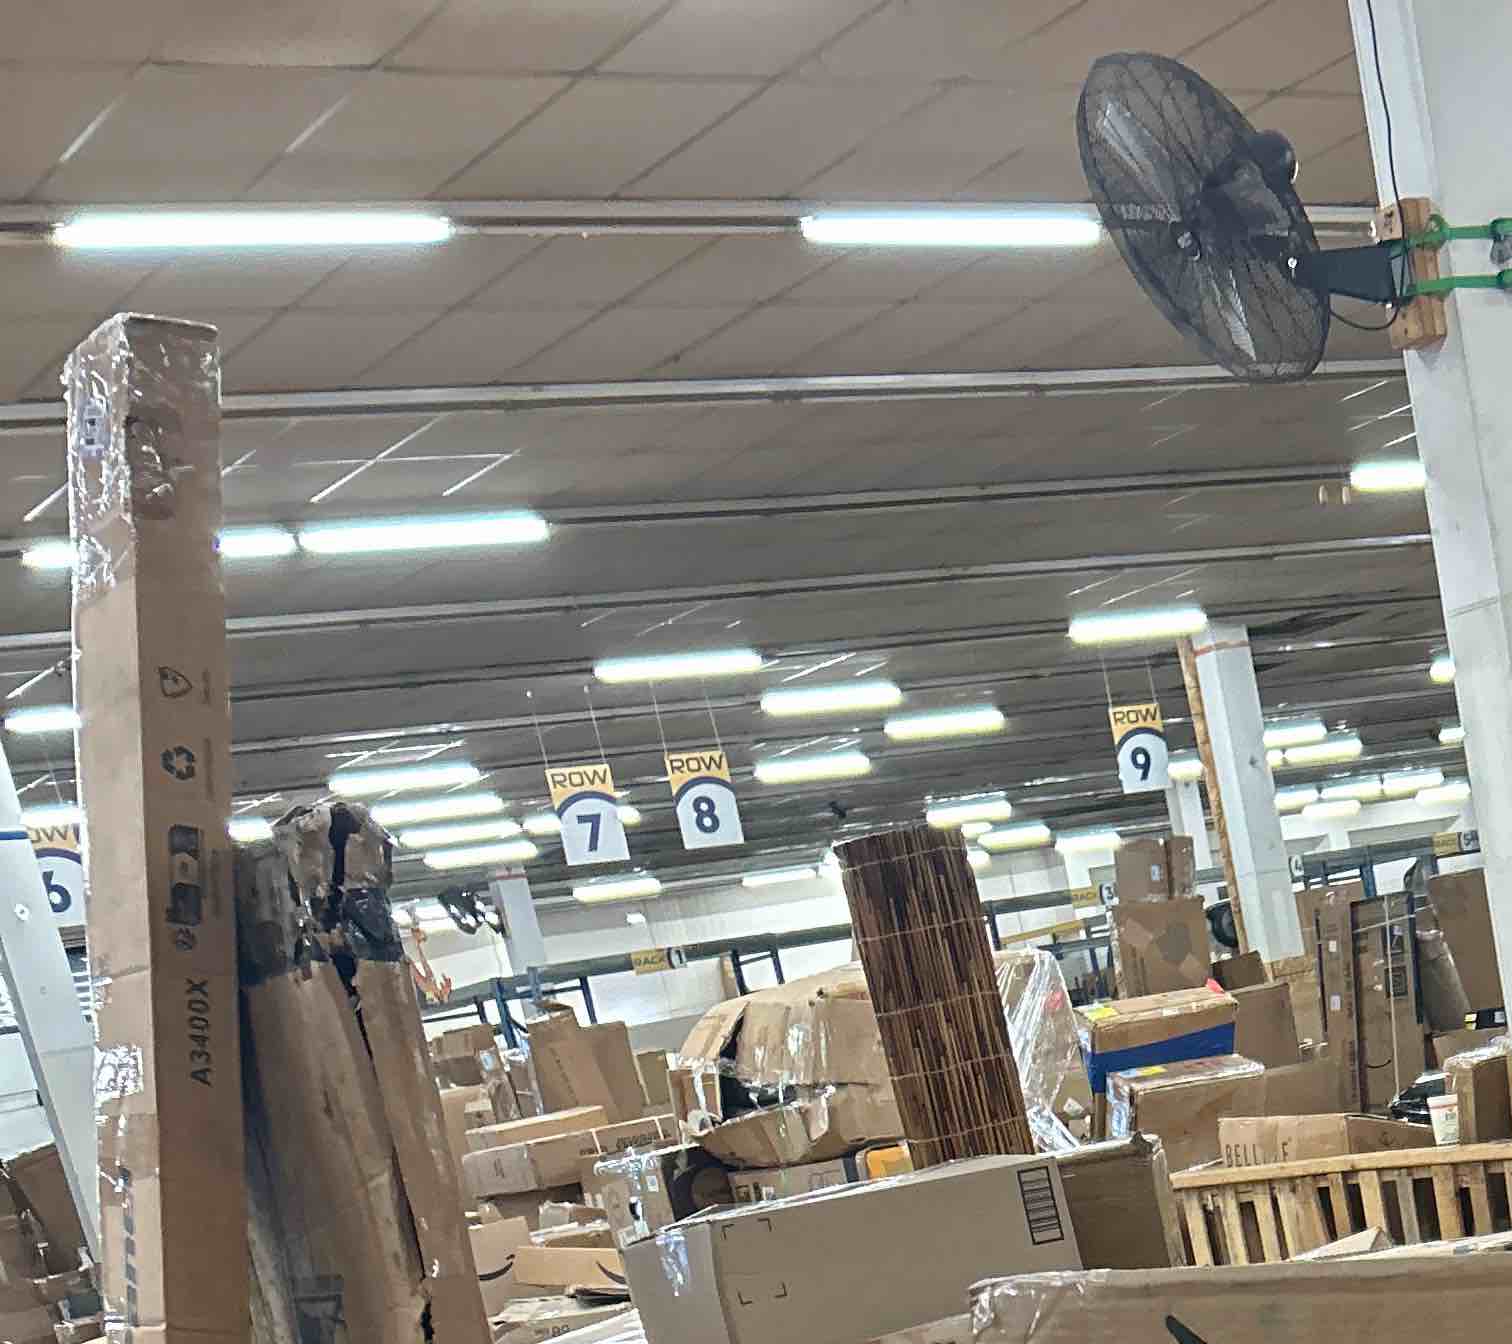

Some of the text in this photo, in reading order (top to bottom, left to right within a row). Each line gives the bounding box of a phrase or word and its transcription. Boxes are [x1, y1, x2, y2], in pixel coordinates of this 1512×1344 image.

[1113, 707, 1158, 725] ROW
[551, 768, 608, 789] ROW
[669, 753, 724, 774] ROW
[1130, 746, 1151, 781] 9
[692, 795, 720, 834] 8
[576, 813, 602, 852] 7
[42, 870, 72, 913] 6
